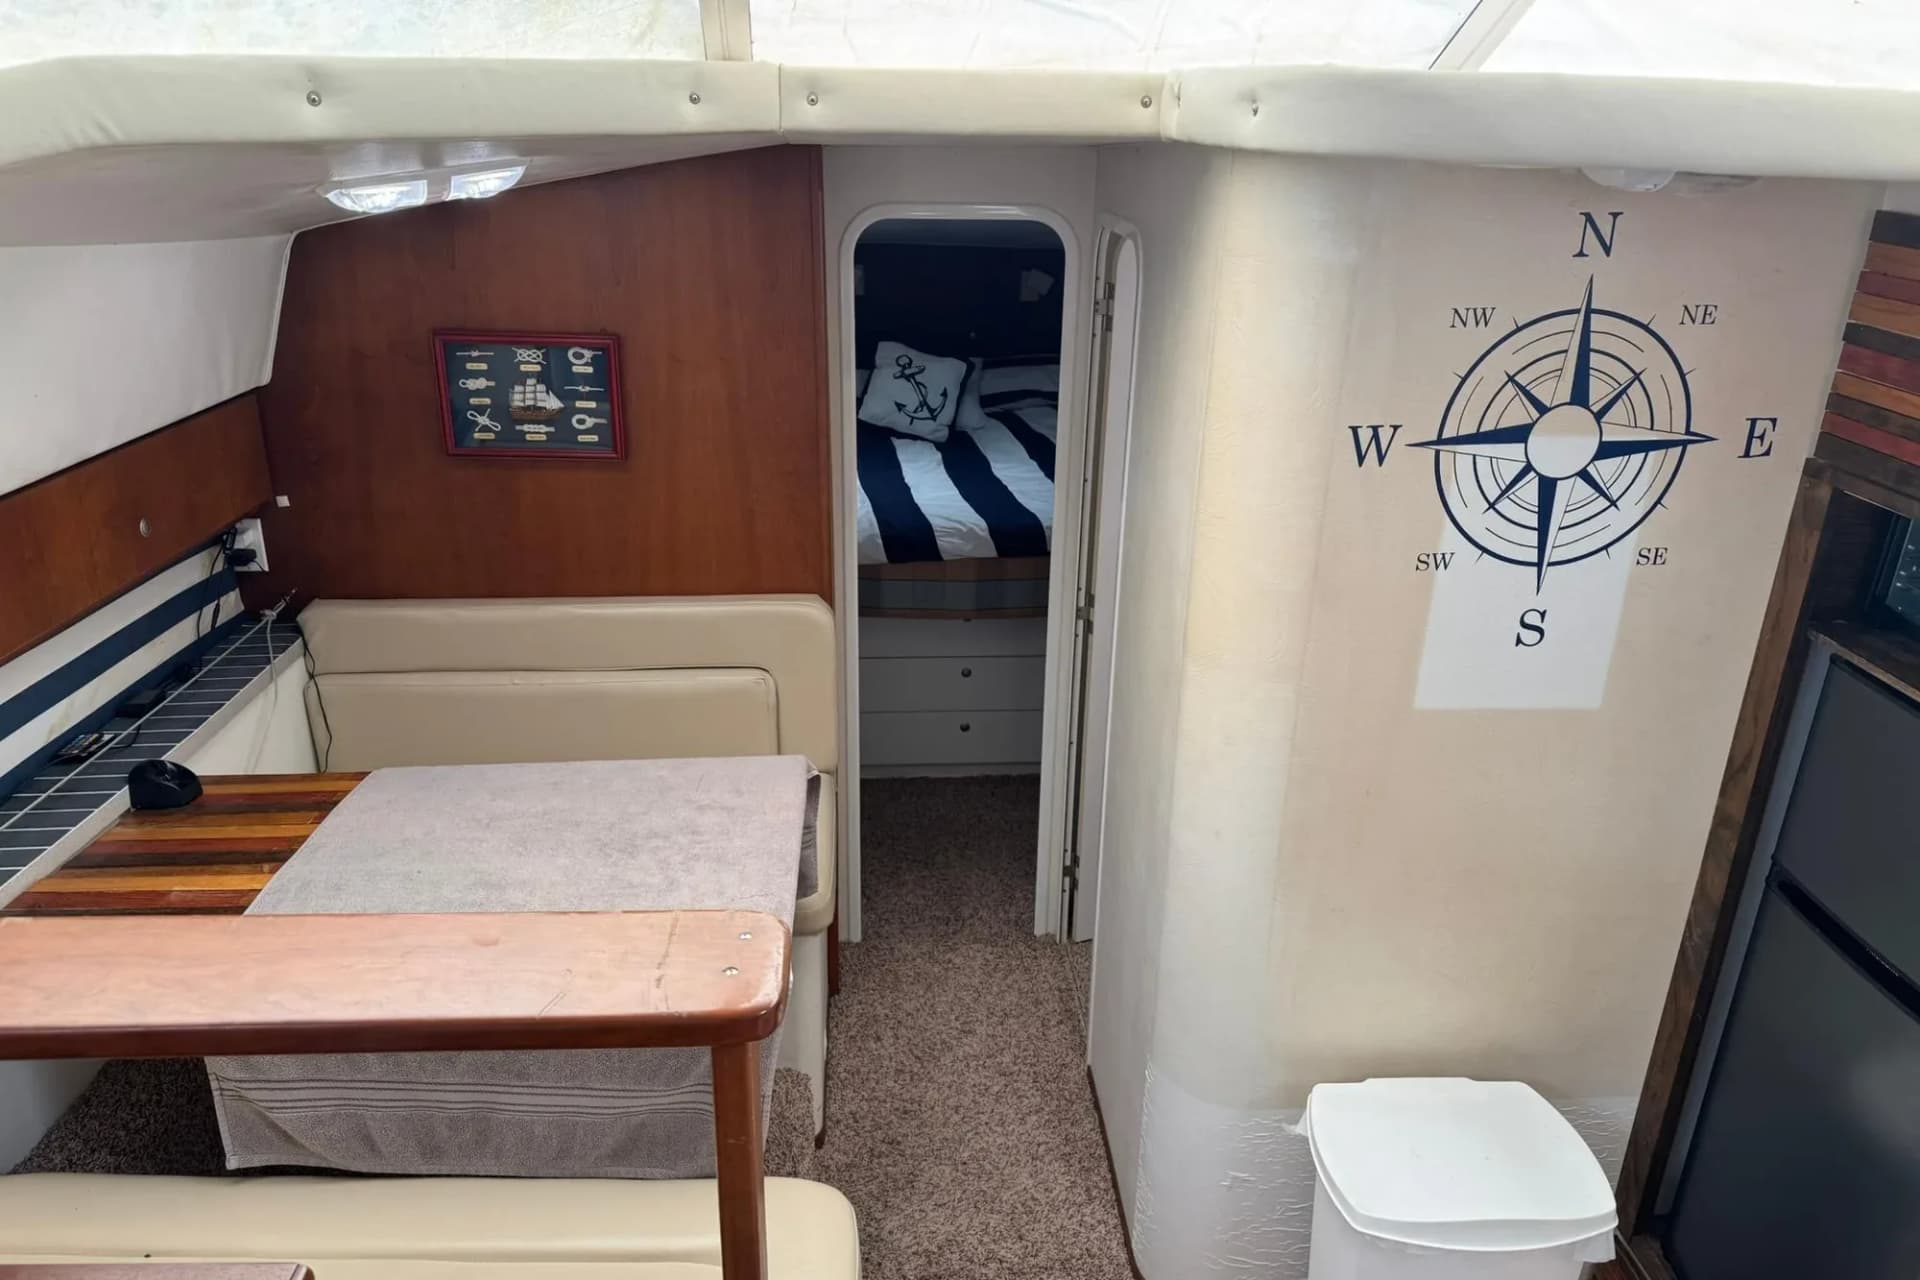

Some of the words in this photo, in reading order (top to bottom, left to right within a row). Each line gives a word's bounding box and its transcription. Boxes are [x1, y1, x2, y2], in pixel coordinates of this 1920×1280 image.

[1572, 211, 1625, 258] N
[1449, 306, 1497, 329] NW
[1679, 304, 1719, 326] NE
[1348, 423, 1404, 469] W
[1736, 417, 1778, 459] E
[1415, 551, 1456, 572] SW
[1635, 546, 1669, 567] SE
[1514, 608, 1548, 648] S
